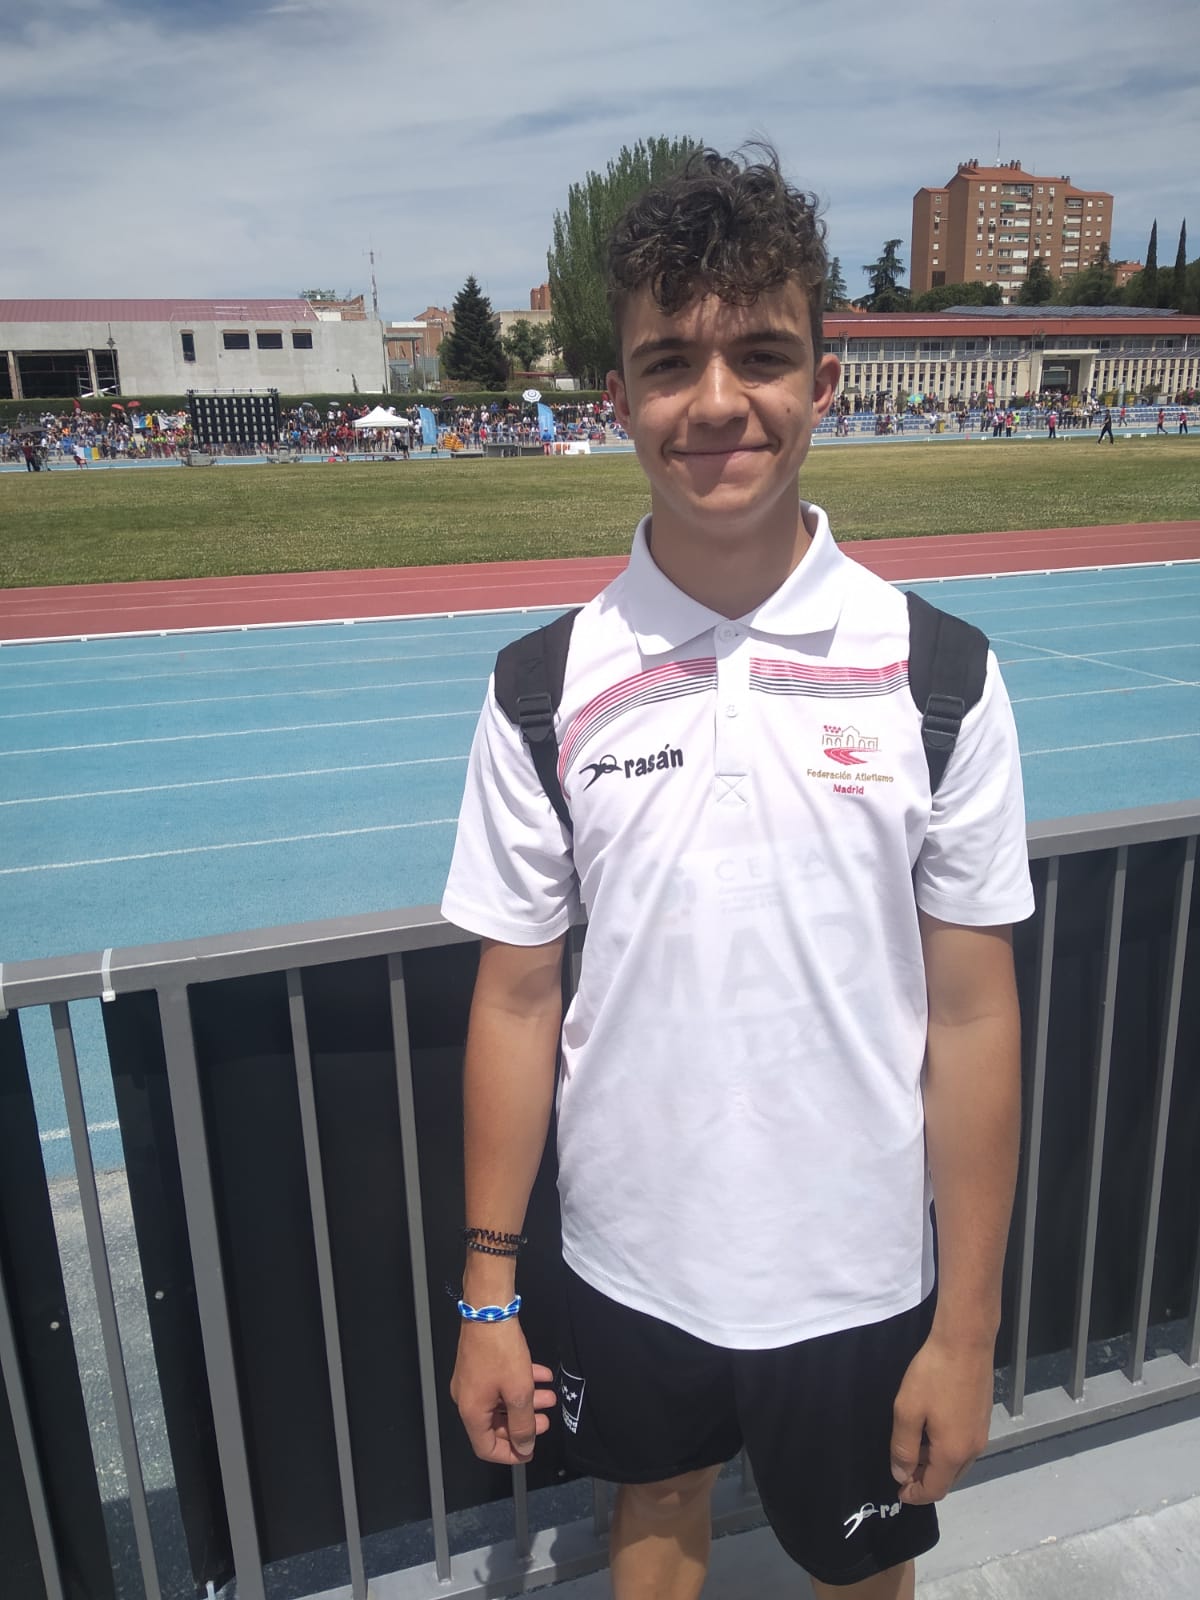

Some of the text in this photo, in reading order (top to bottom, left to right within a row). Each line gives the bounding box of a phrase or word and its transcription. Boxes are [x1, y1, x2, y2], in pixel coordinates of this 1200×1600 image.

[624, 743, 684, 779] rasán
[806, 768, 895, 783] Federación Atletismo
[833, 783, 865, 795] Madrid
